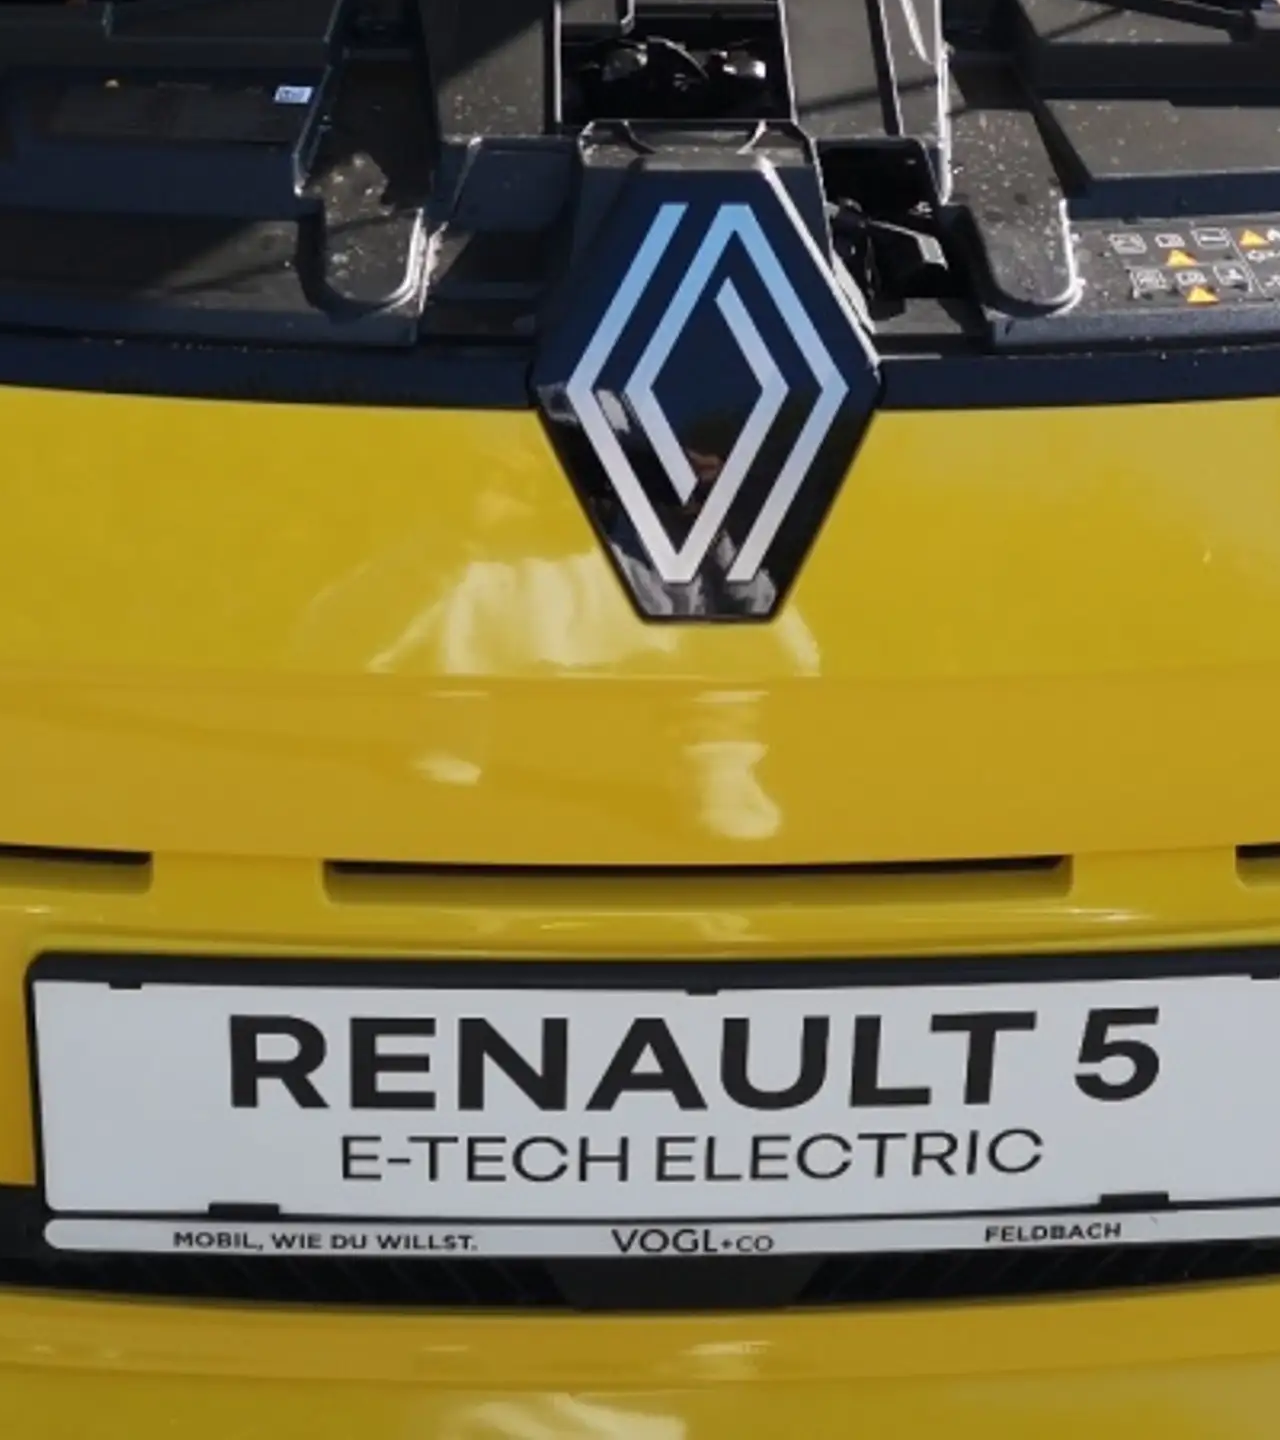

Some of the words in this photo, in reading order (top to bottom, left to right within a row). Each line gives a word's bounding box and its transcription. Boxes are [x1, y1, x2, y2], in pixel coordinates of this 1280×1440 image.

[229, 1011, 1037, 1112] RENAULT
[1074, 1006, 1160, 1102] 5
[341, 1135, 630, 1183] E-TECH
[655, 1128, 1044, 1183] ELECTRIC
[172, 1230, 265, 1253] MOBIL,
[269, 1232, 323, 1250] WIE
[329, 1233, 368, 1250] DU
[375, 1233, 478, 1251] WILLST.
[984, 1221, 1123, 1243] FELDBACH
